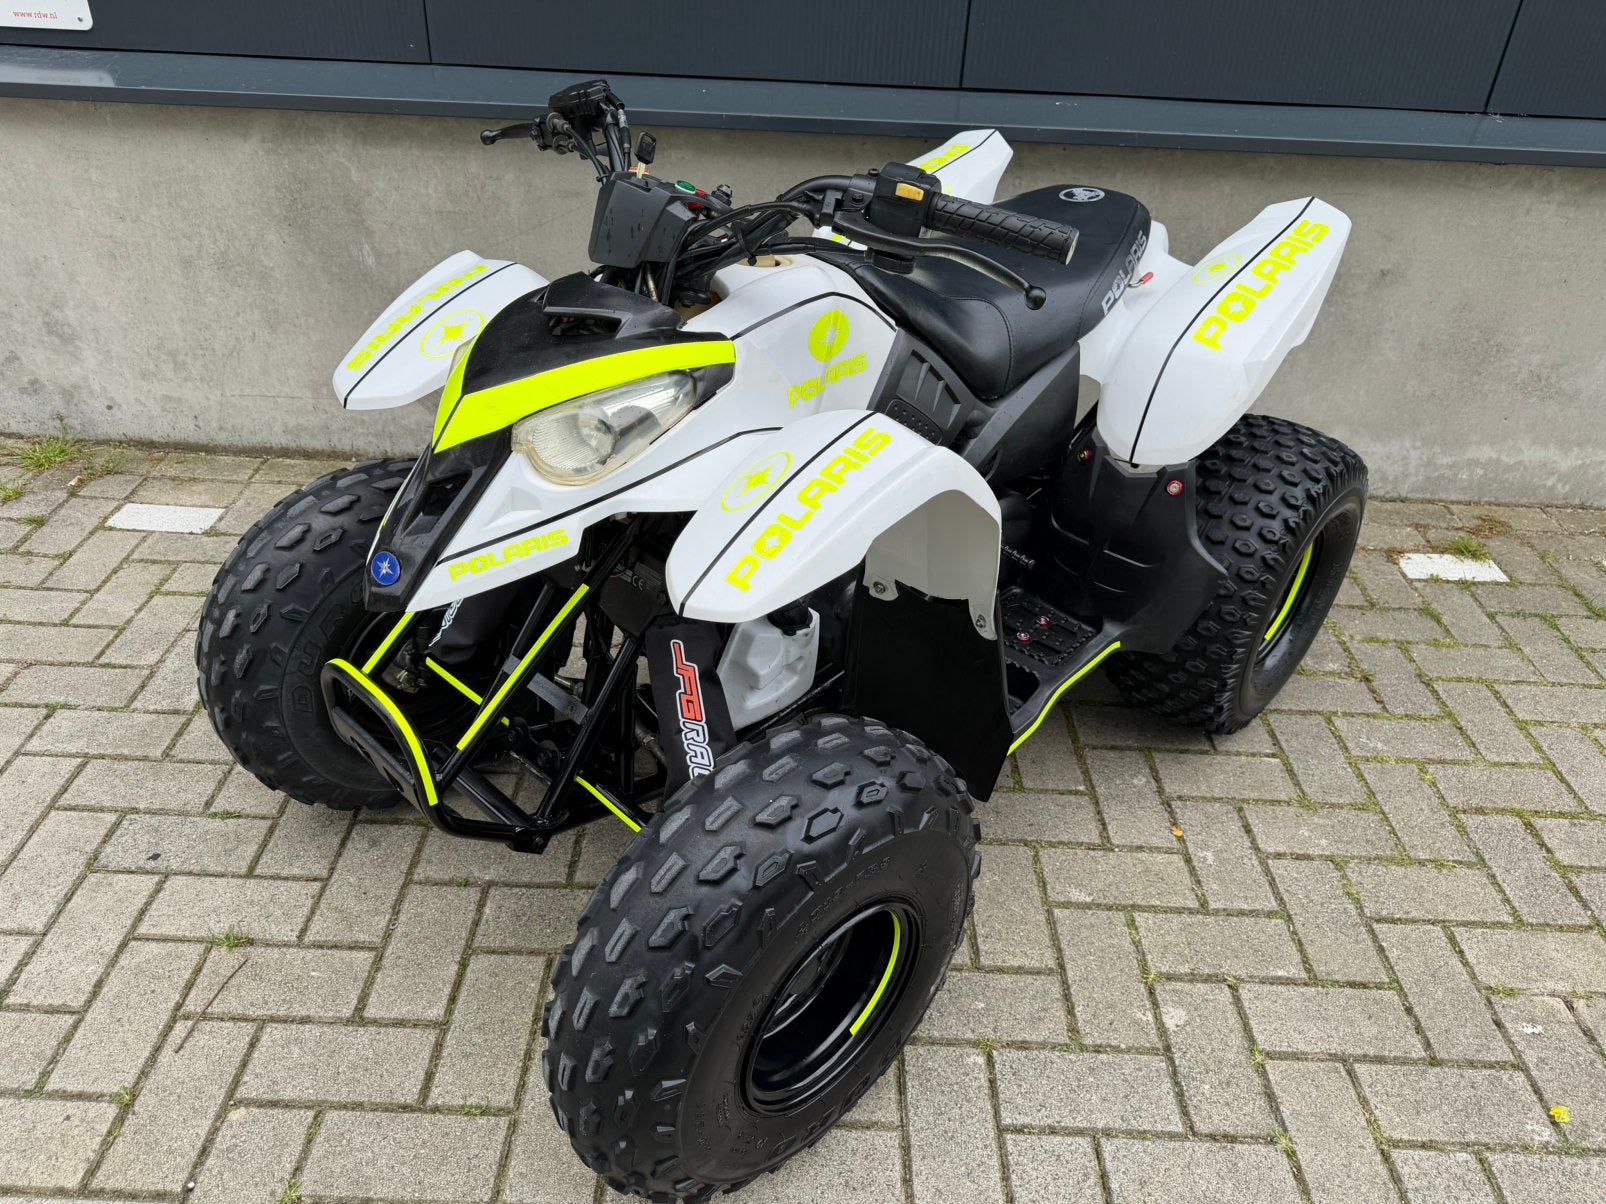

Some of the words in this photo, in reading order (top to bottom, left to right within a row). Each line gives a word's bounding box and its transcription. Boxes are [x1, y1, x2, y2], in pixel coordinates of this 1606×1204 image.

[12, 10, 58, 19] www.rdw.nl
[1101, 229, 1149, 317] POLARIS
[1191, 218, 1331, 352] POLARIS
[347, 264, 489, 372] POLARIS
[788, 352, 868, 409] POLARIS
[724, 427, 893, 593] POLARIS
[448, 528, 570, 582] POLARIS
